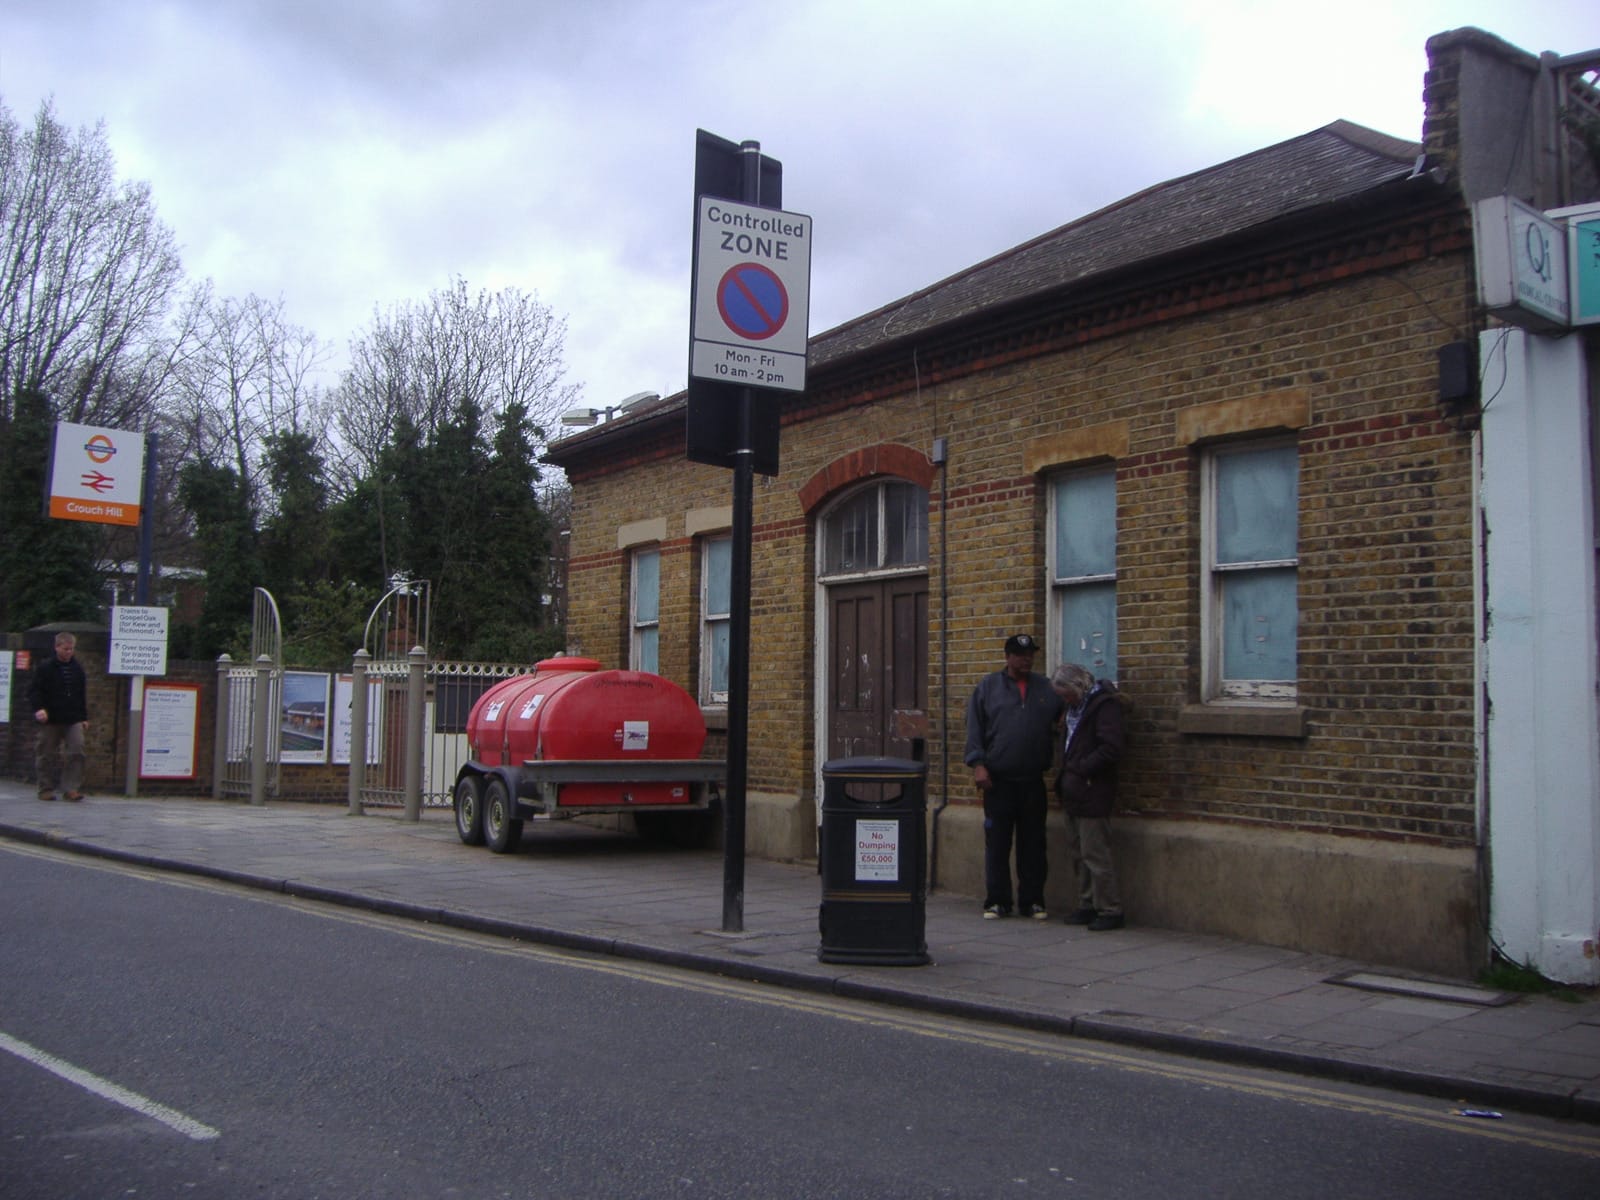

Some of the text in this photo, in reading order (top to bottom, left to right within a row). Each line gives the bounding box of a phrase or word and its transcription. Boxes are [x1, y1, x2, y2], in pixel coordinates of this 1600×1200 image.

[708, 206, 804, 238] Controlled
[720, 231, 788, 260] ZONE
[1527, 222, 1552, 282] Qi
[726, 350, 750, 363] Mon
[760, 355, 776, 367] Fri
[67, 502, 124, 517] Crouch Hill
[859, 841, 896, 850] Dumping
[861, 855, 893, 863] £50,000
